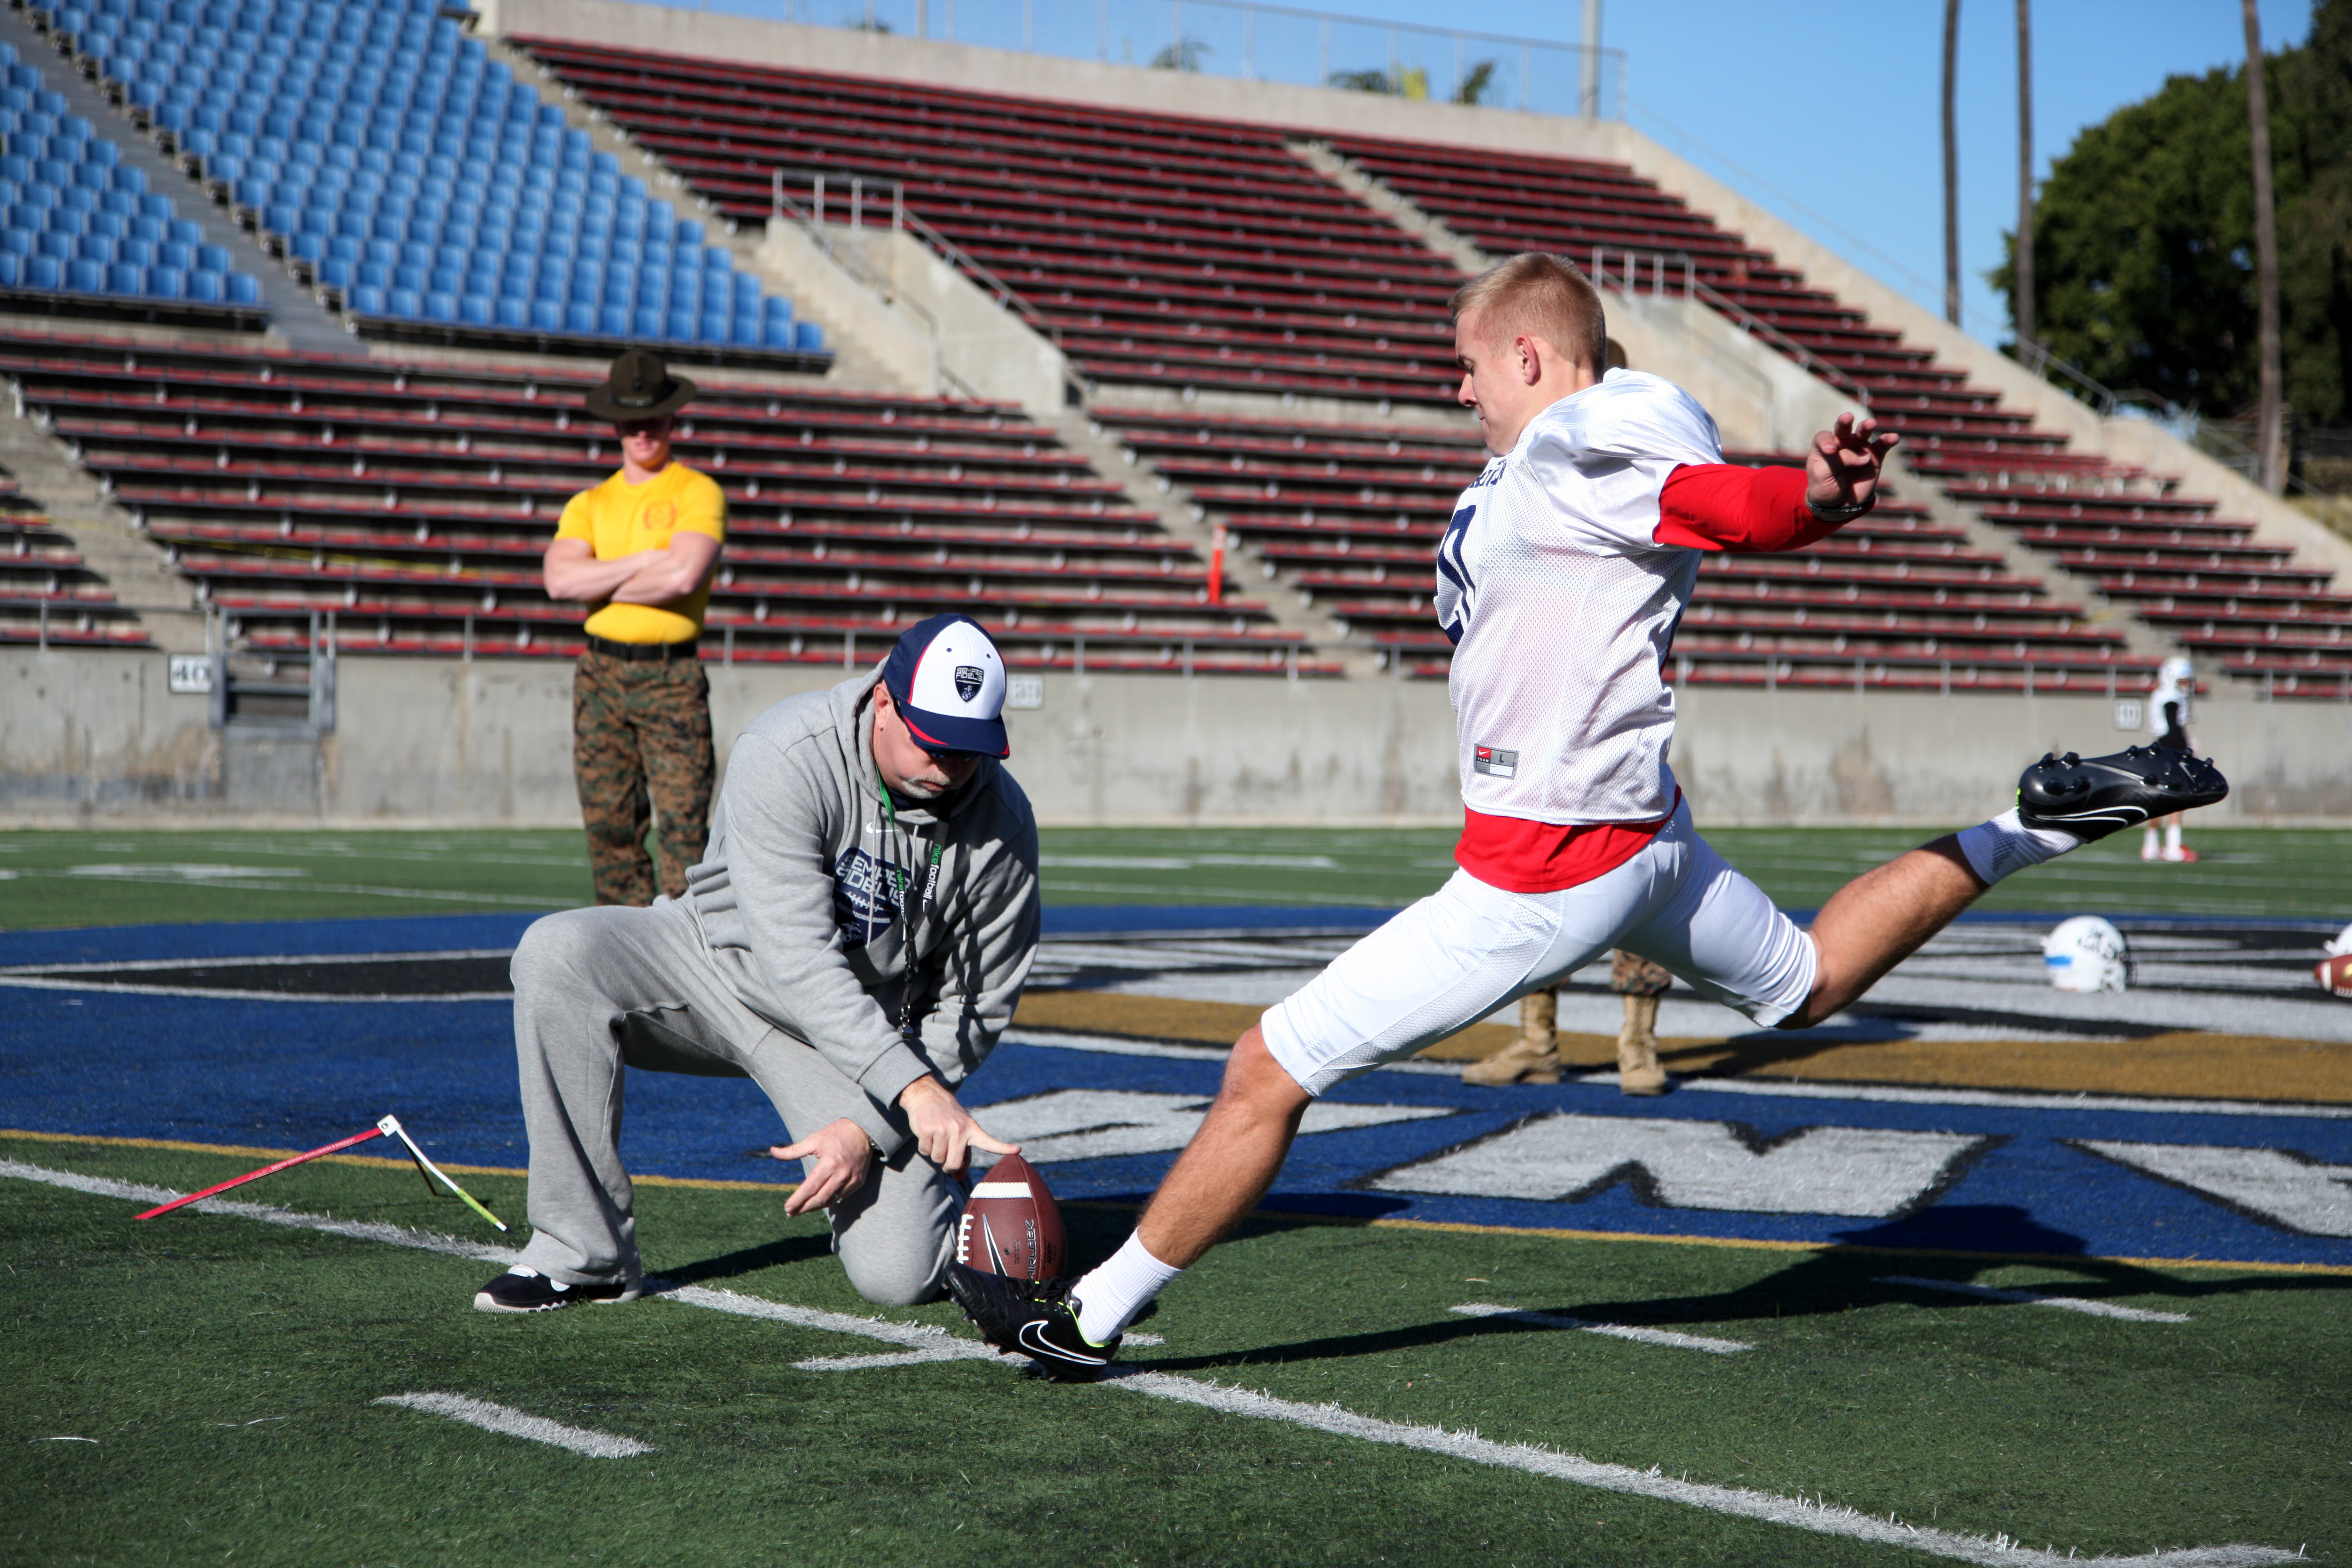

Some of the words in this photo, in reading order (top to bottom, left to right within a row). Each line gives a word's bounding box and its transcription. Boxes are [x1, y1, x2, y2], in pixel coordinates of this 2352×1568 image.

[1499, 753, 1504, 763] L
[923, 843, 941, 900] nikefootball
[1025, 1219, 1037, 1280] AIRLOCK
